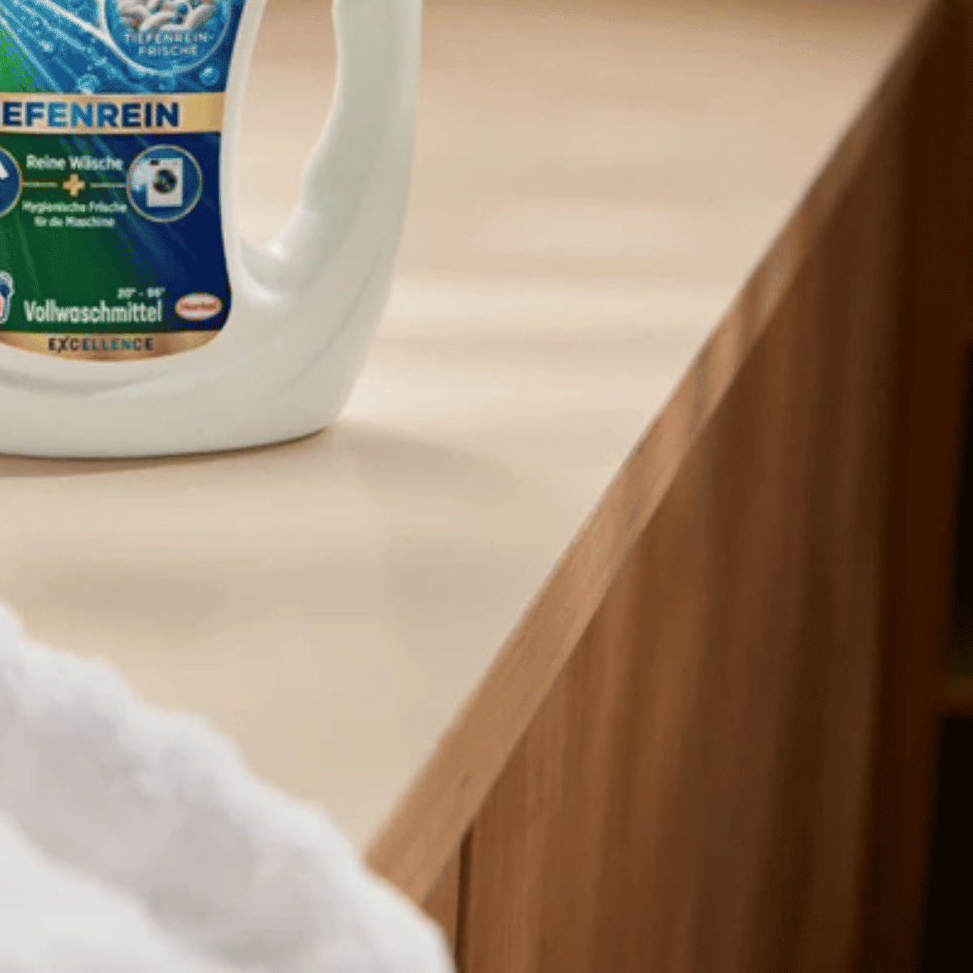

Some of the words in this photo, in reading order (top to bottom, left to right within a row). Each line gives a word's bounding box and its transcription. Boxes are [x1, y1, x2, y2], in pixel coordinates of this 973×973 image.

[26, 154, 67, 170] Reine
[69, 154, 124, 171] Wäsche
[23, 299, 163, 323] Vollwaschmittel
[48, 336, 154, 352] EXCELLENCE
